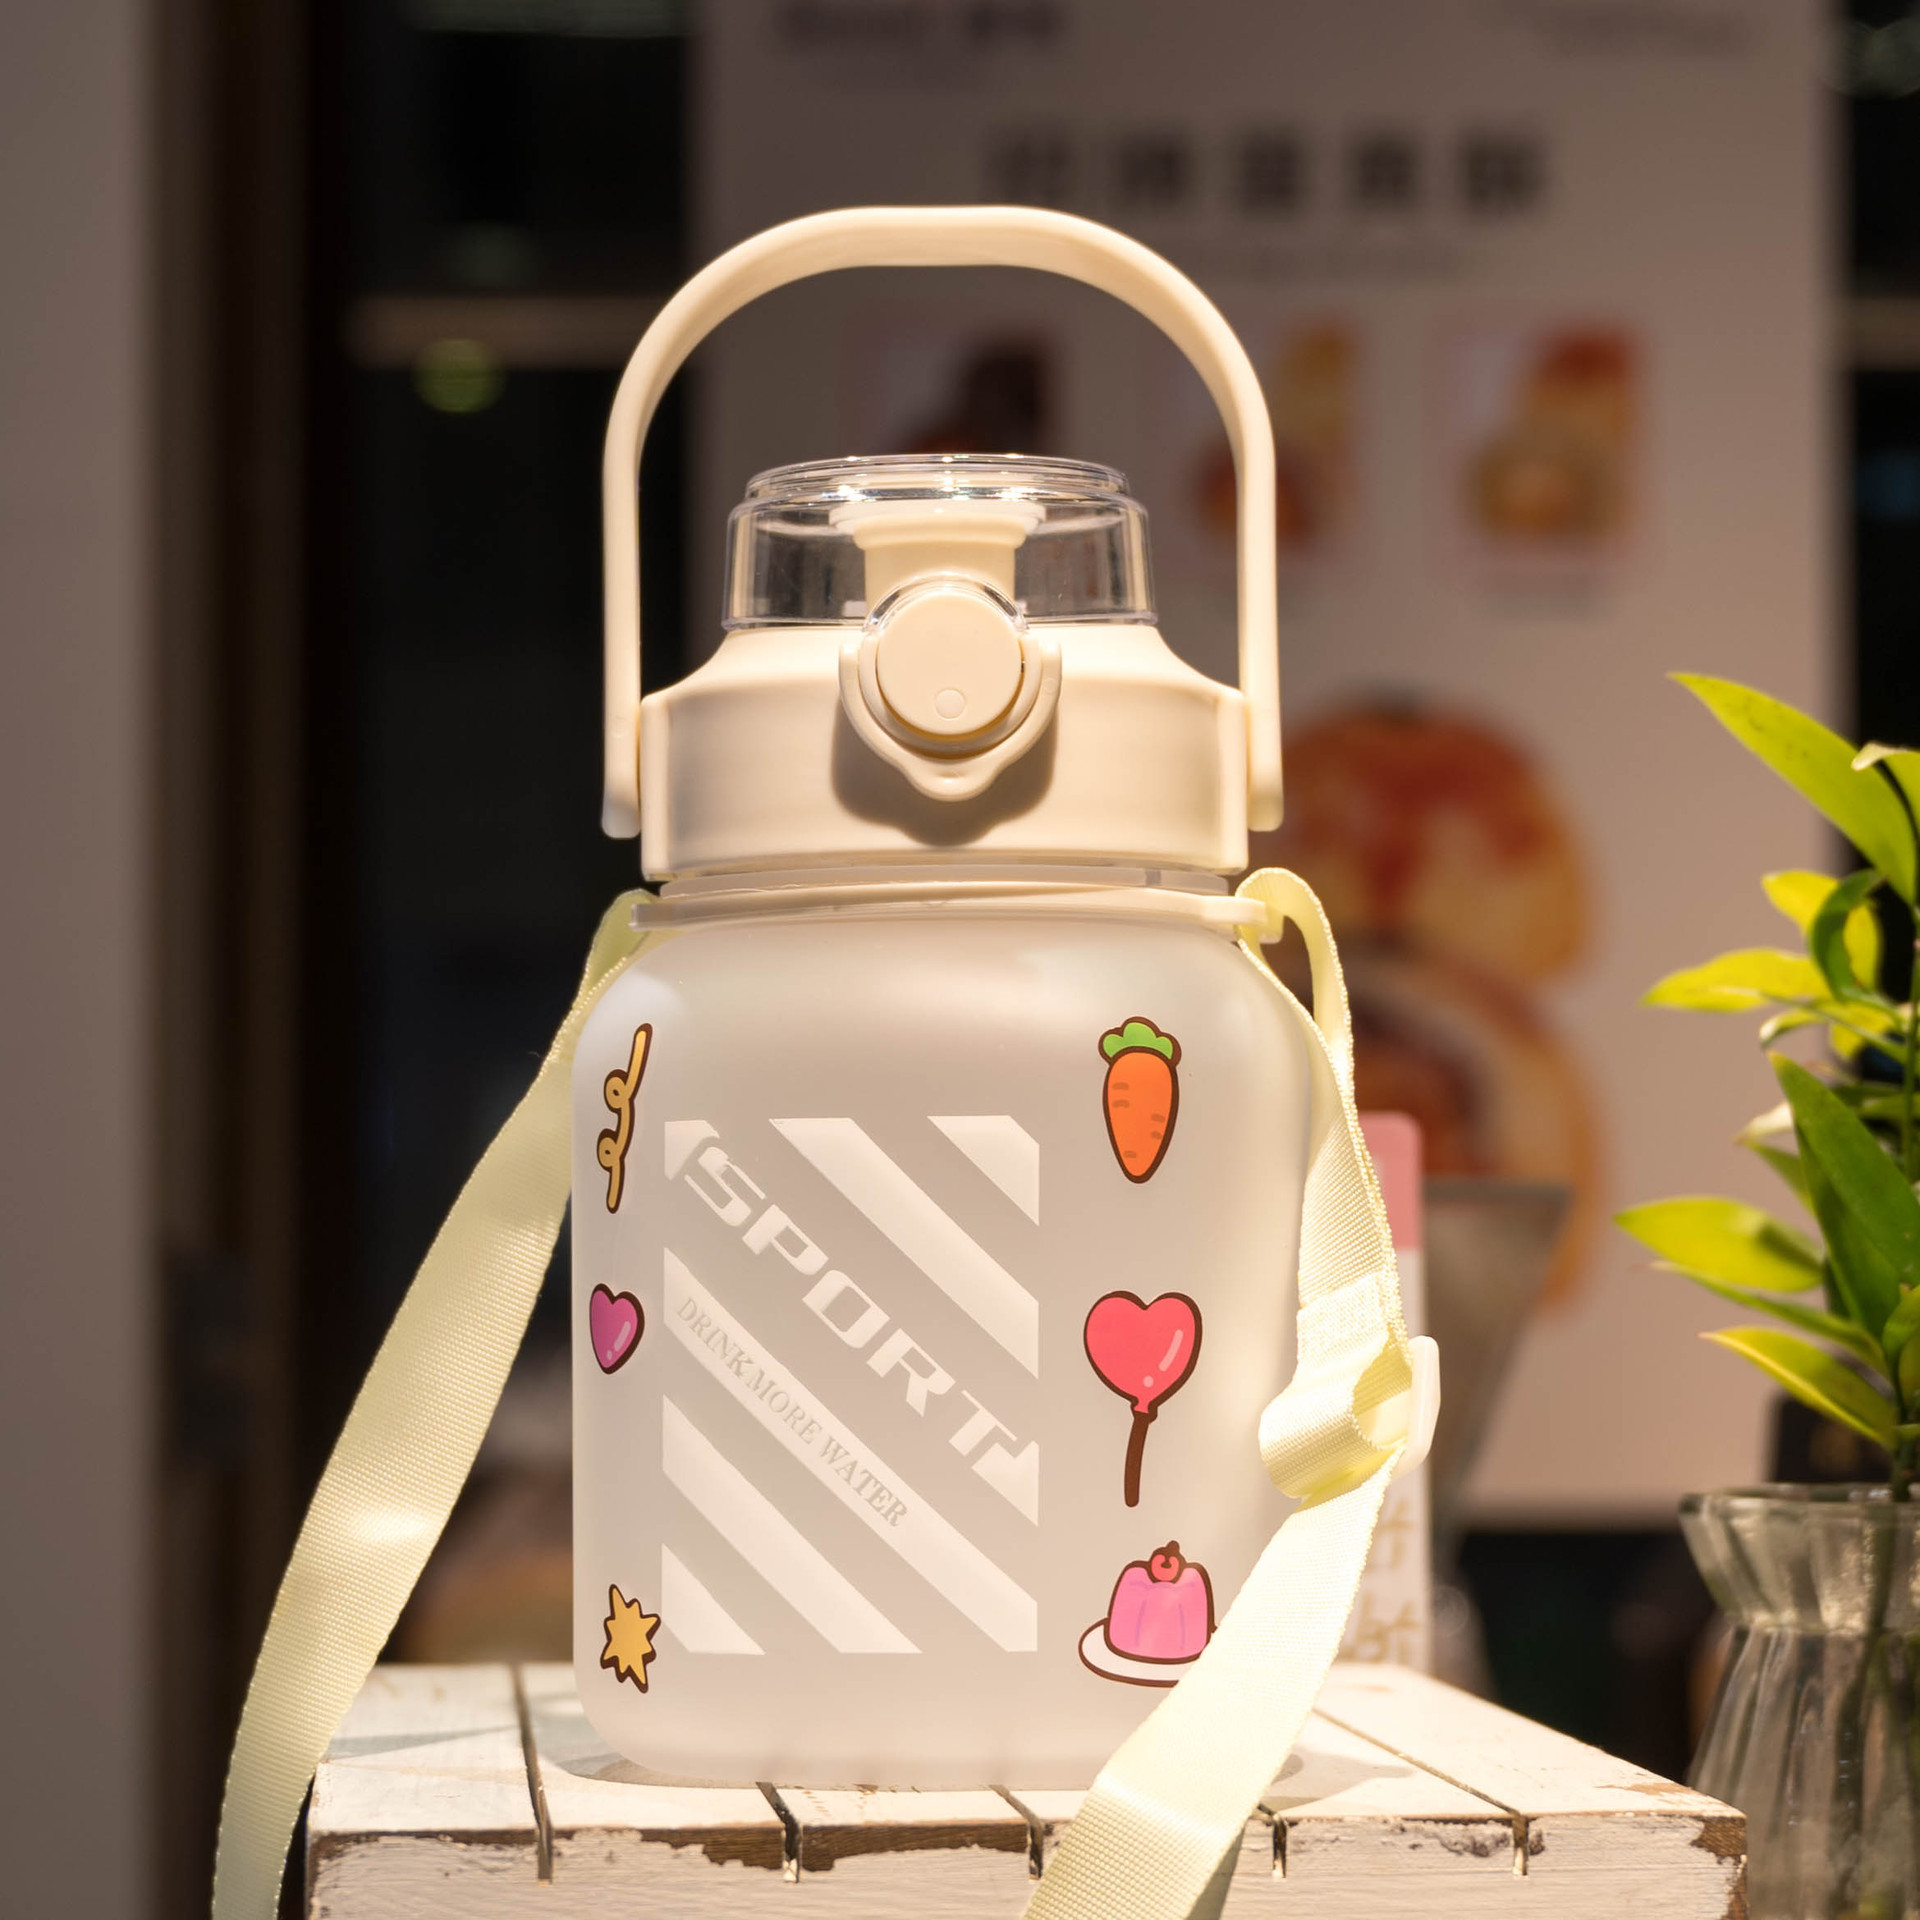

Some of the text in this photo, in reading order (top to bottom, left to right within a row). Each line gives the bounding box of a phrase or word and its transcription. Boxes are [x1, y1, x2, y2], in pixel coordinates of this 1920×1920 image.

[678, 1298, 908, 1527] DRINK MORE WATER
[684, 1147, 1018, 1456] SPORT
